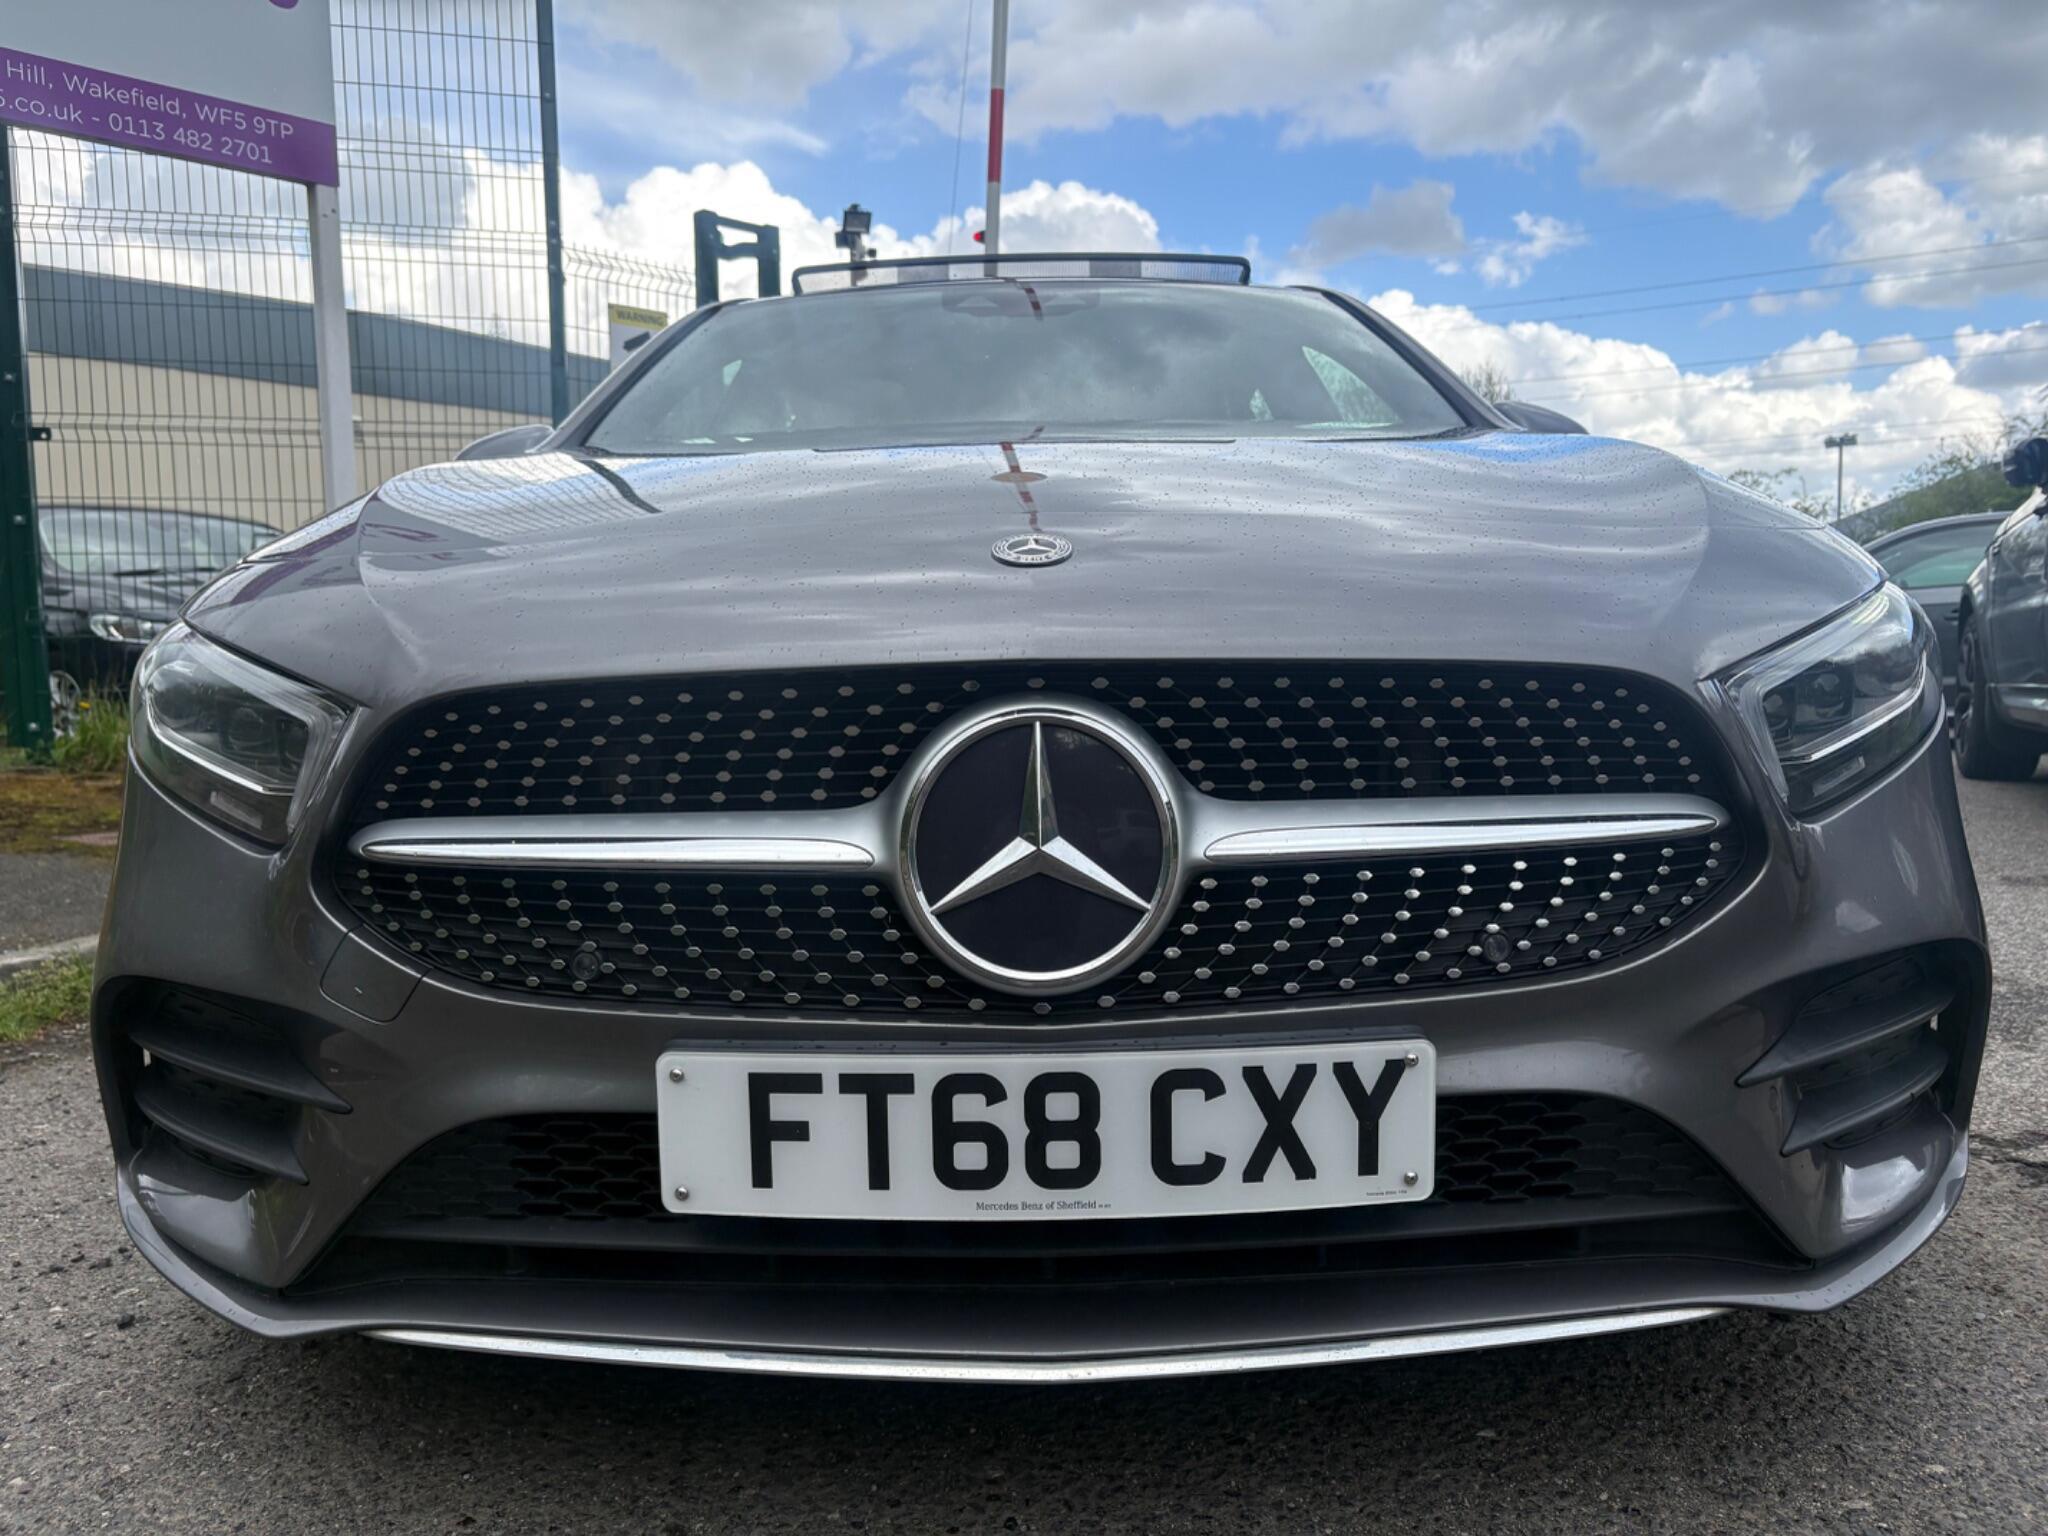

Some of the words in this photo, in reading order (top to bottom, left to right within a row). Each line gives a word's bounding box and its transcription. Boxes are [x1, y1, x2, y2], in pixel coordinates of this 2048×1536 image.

[6, 59, 53, 89] Hill,
[62, 71, 186, 119] Wakefield,
[194, 102, 247, 130] WF5
[253, 116, 294, 139] 9TP
[108, 112, 166, 141] 0113
[173, 127, 213, 151] 482
[221, 137, 273, 164] 2701
[616, 309, 664, 326] WARNING
[748, 1071, 1102, 1191] FT68
[1150, 1058, 1407, 1187] CXY
[975, 1201, 1019, 1211] Mercedes
[1021, 1201, 1044, 1211] Benz
[1045, 1201, 1055, 1210] of
[1056, 1200, 1097, 1210] Sheffield
